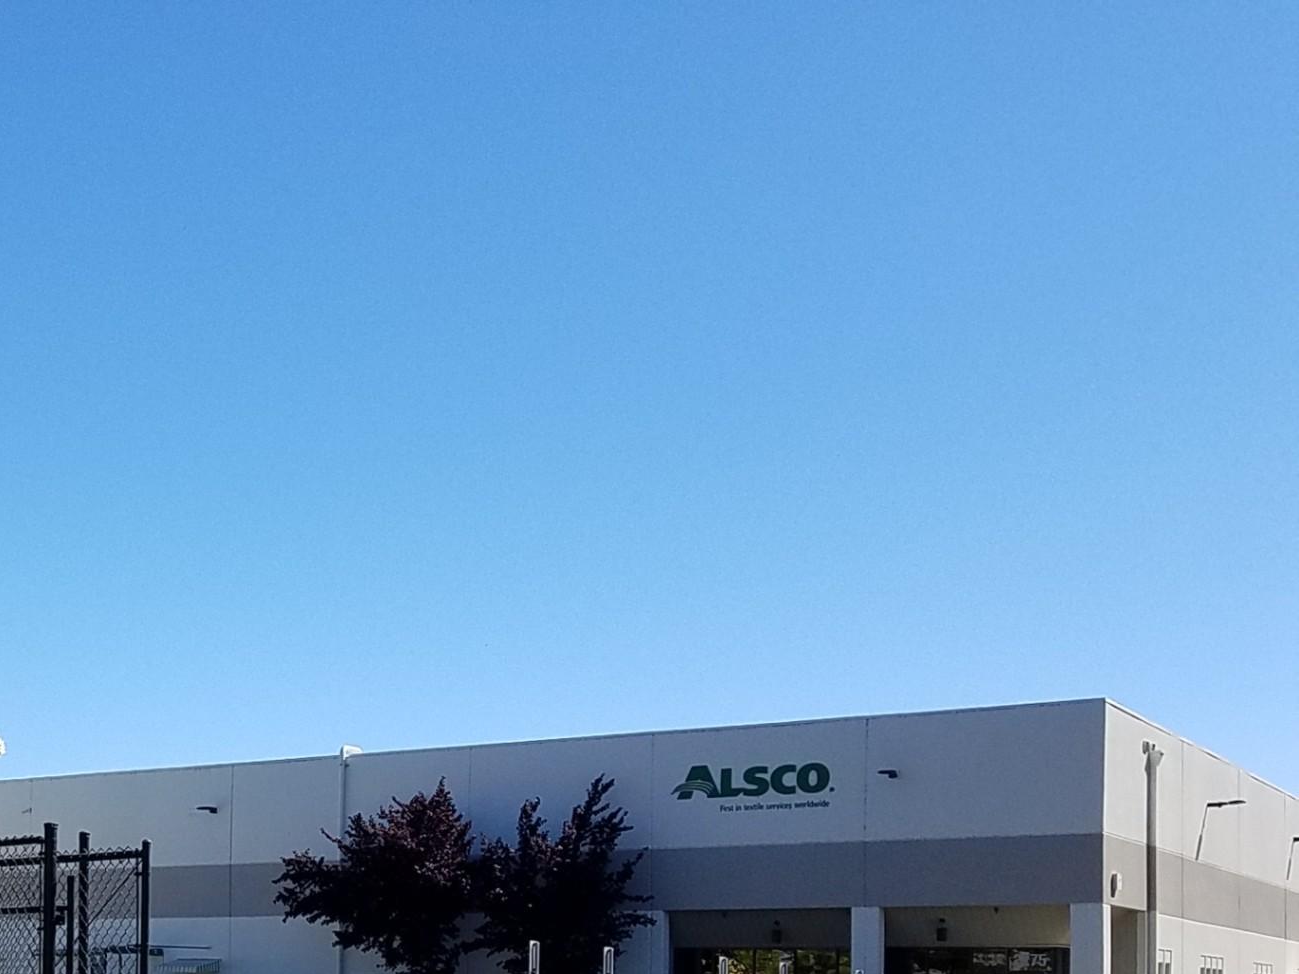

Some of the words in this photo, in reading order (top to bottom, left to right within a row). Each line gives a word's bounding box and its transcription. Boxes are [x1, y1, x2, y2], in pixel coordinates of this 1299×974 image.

[672, 762, 831, 800] ALSCO
[720, 804, 734, 812] First
[735, 804, 742, 812] in
[743, 803, 764, 811] textile
[794, 800, 830, 809] worldwide
